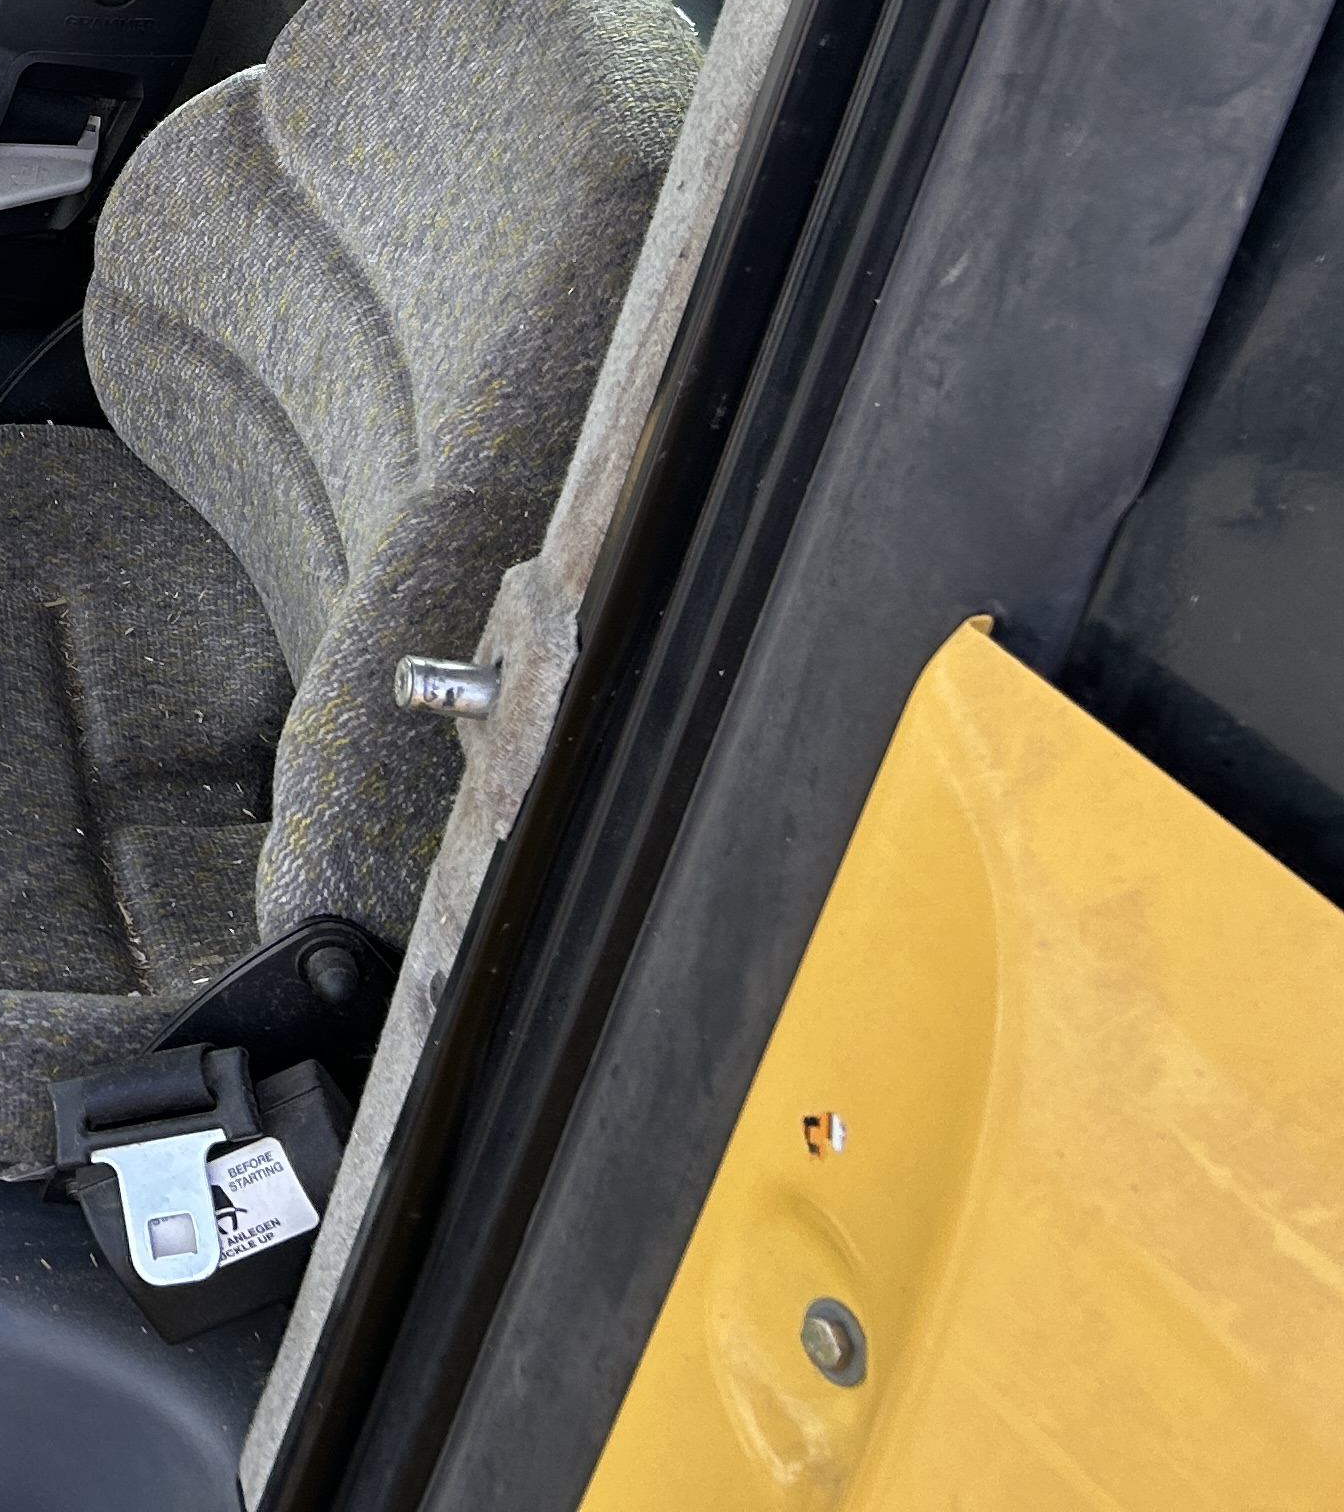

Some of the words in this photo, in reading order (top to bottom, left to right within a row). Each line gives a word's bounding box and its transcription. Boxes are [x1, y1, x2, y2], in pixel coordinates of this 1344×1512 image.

[228, 1151, 274, 1179] BEFORE
[228, 1161, 284, 1192] STARTING
[220, 1240, 258, 1261] UCKLE
[257, 1232, 275, 1244] UP
[227, 1218, 281, 1247] ANLEGEN
